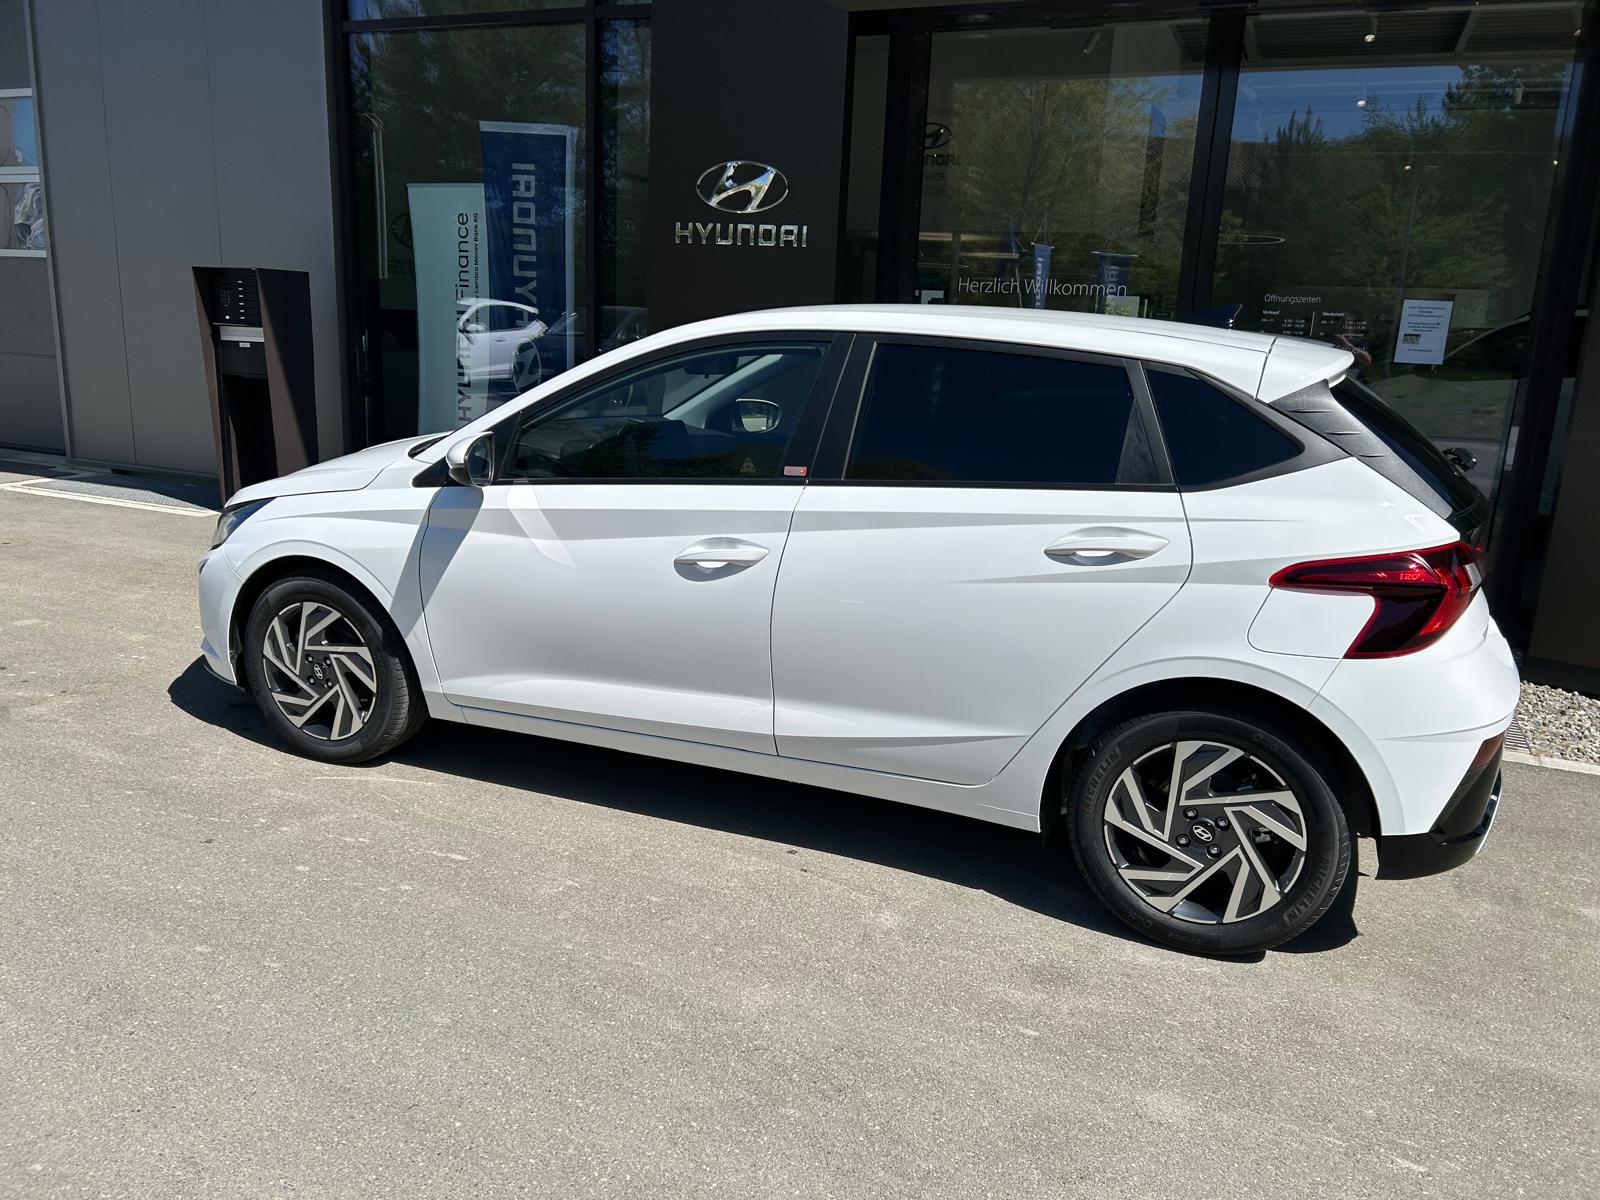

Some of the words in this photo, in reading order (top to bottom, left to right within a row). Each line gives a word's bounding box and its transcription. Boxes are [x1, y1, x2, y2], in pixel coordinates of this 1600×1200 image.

[472, 212, 479, 223] AG
[674, 221, 808, 248] HYUNDAI
[455, 212, 470, 301] Finance
[958, 276, 1020, 294] Herzlich
[1024, 277, 1127, 297] Willkommen
[1080, 747, 1121, 817] MICHELIN
[1286, 857, 1331, 923] MICHELIN
